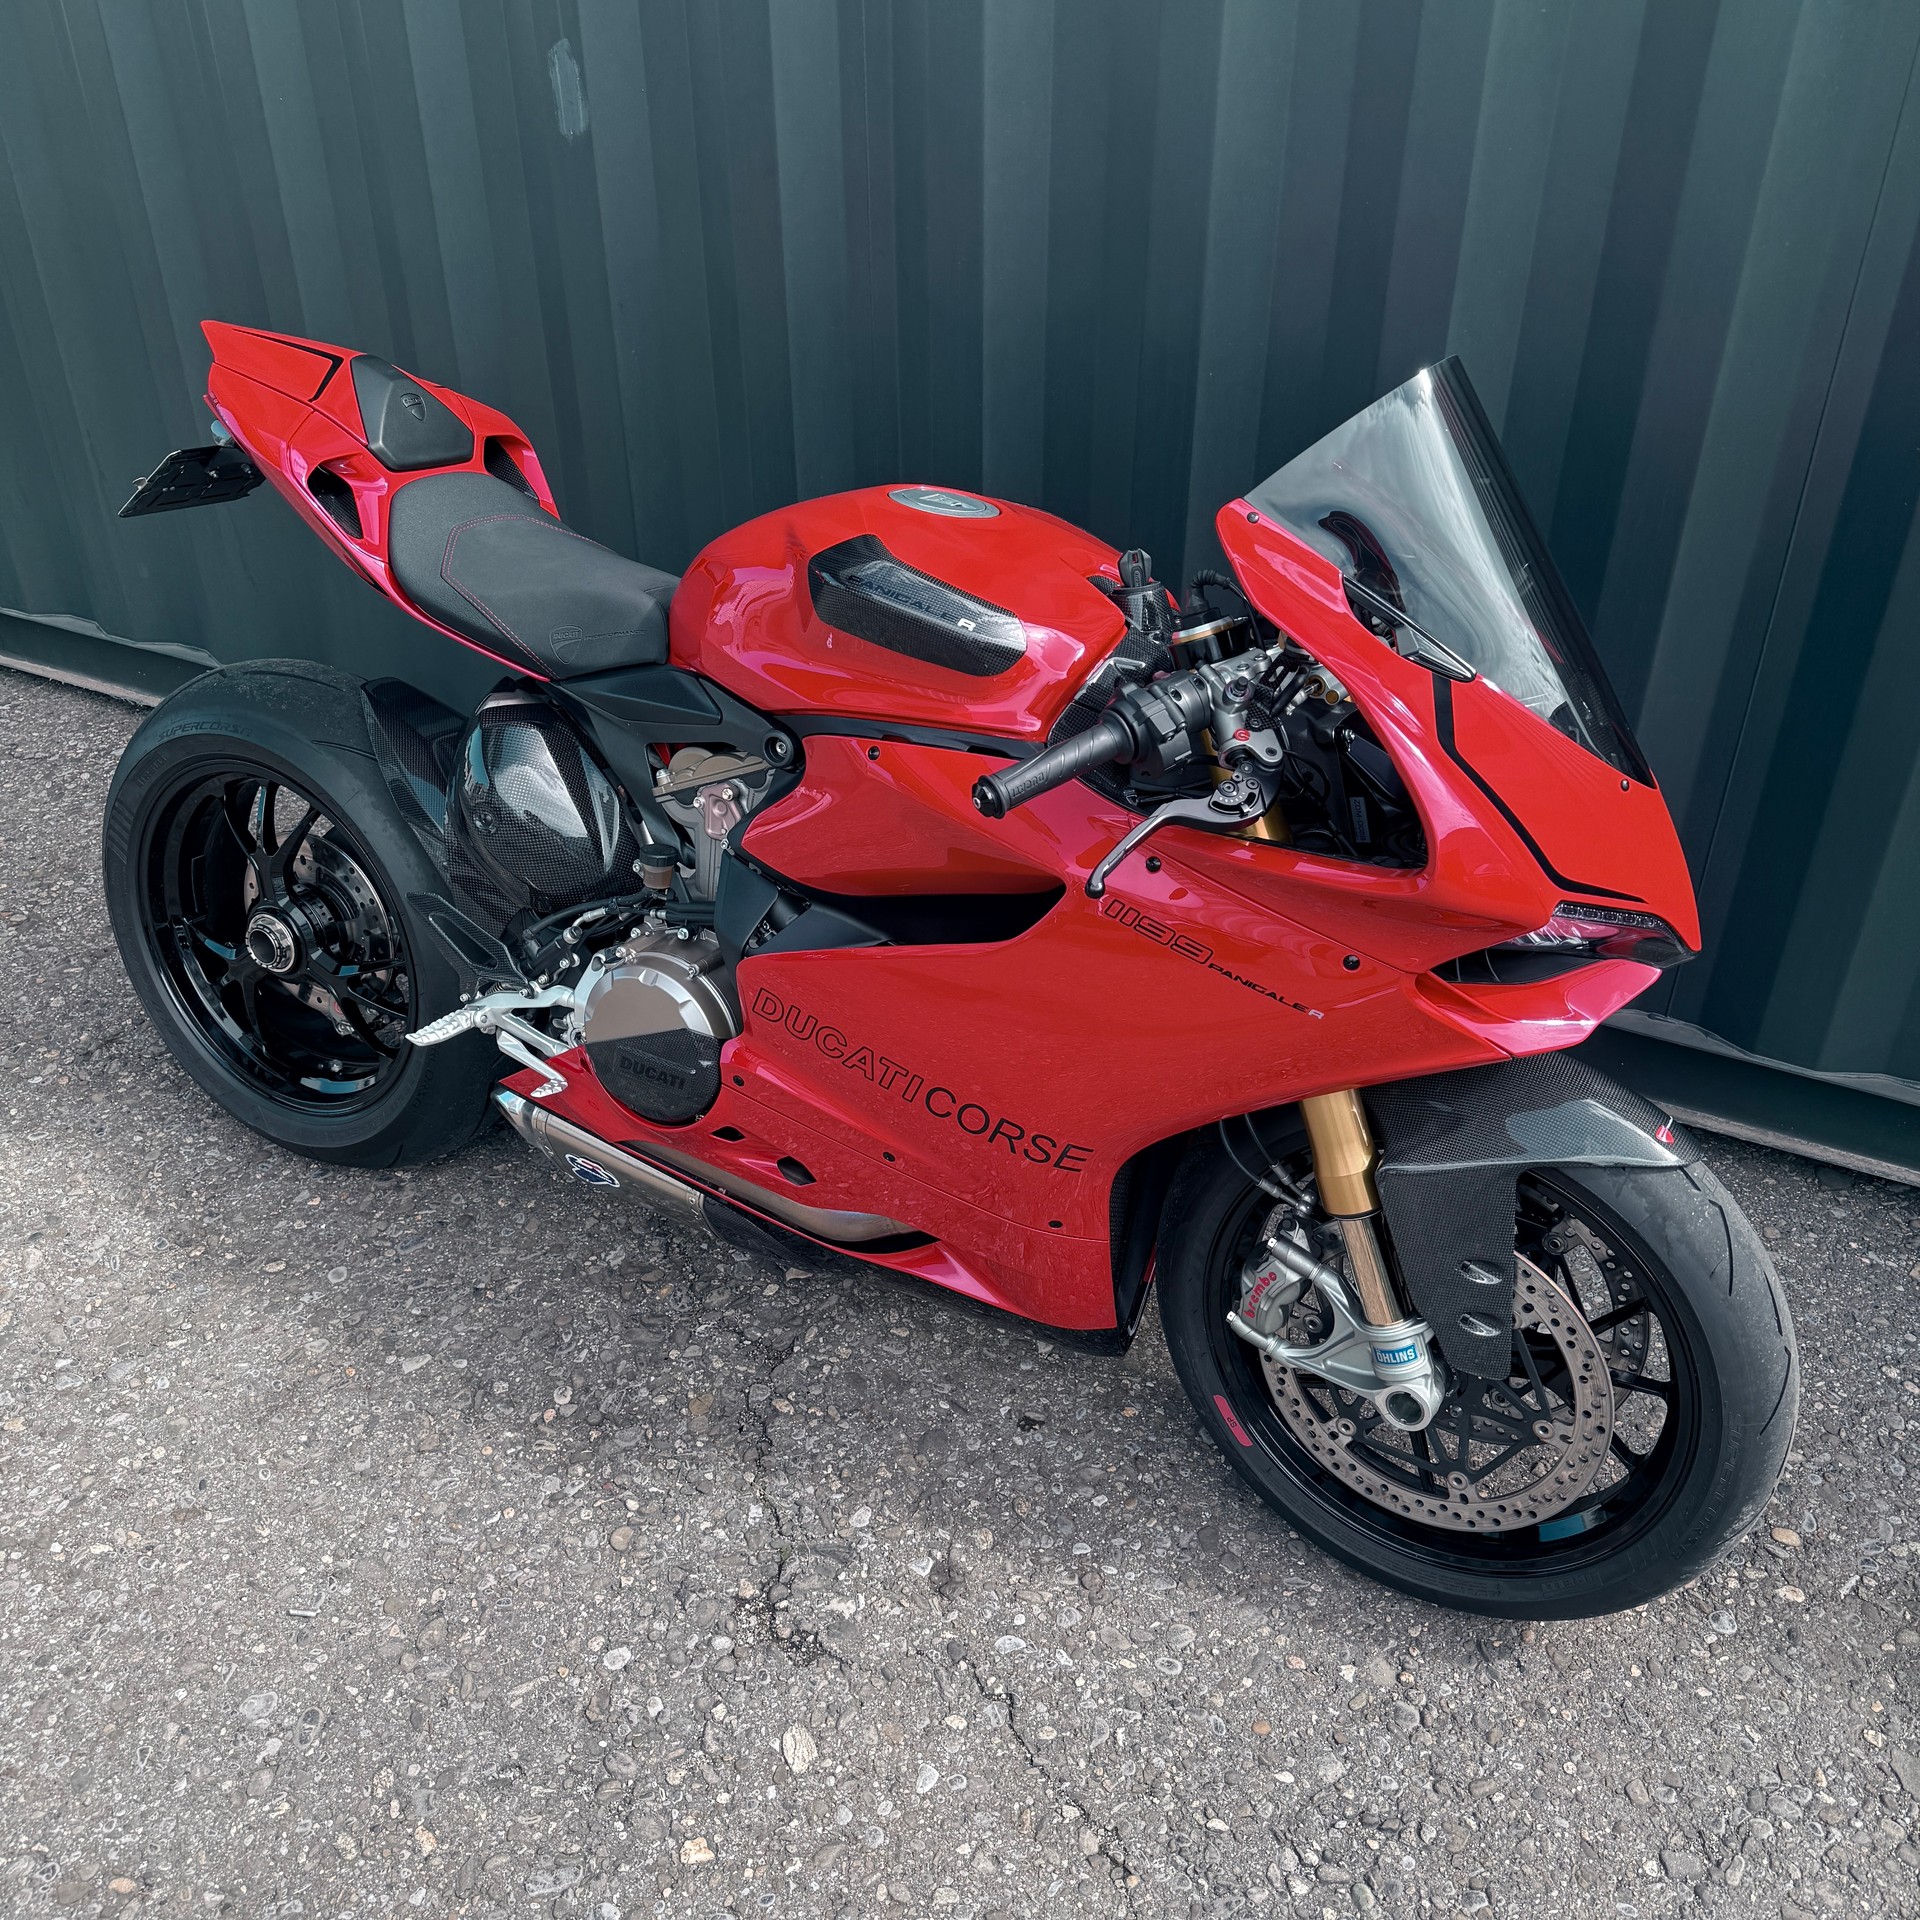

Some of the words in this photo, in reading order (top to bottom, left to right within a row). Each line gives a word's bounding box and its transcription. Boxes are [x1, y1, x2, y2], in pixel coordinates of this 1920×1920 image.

[957, 618, 976, 632] R
[1104, 899, 1214, 965] 1199
[1207, 962, 1309, 1014] PANIGALE
[1308, 1008, 1325, 1020] R
[619, 1055, 686, 1090] DUCATI
[1243, 1271, 1278, 1319] brembo
[1376, 1348, 1416, 1364] ÖHLINS
[1226, 1416, 1238, 1428] SP
